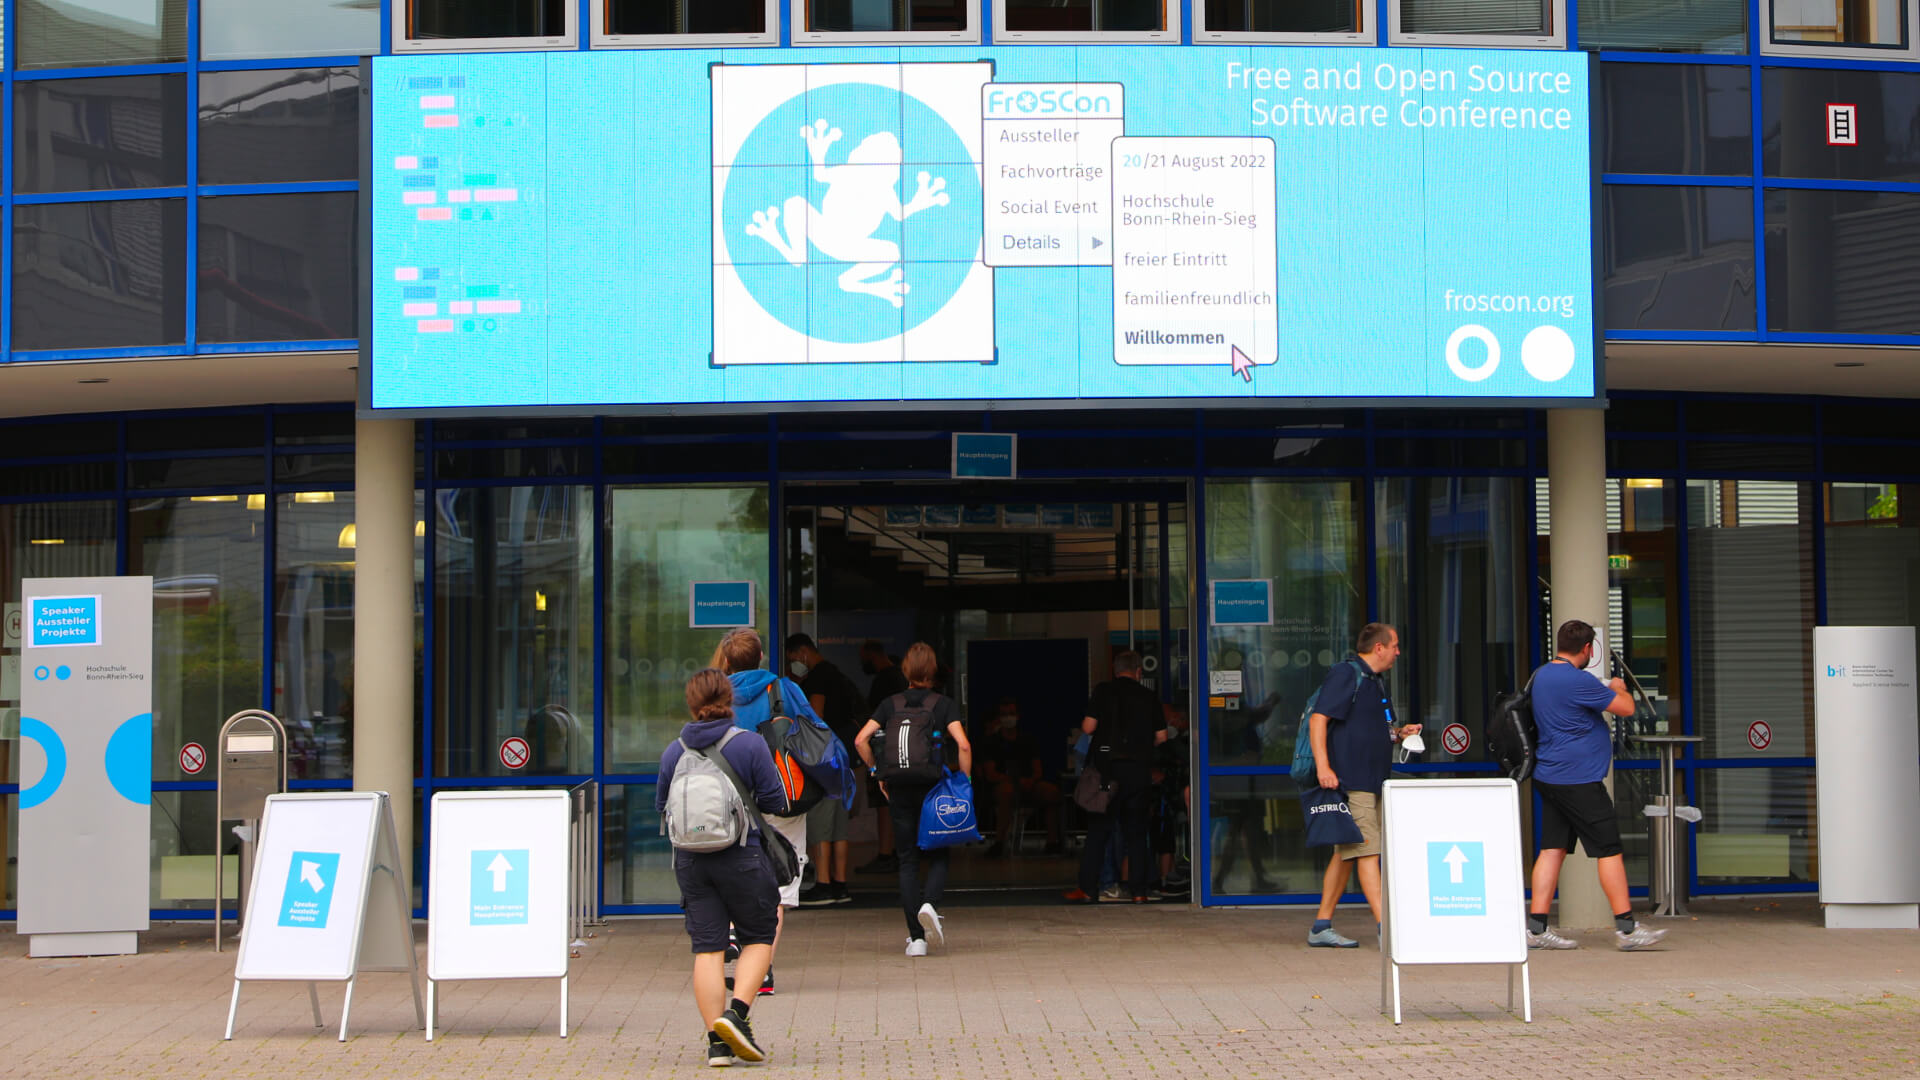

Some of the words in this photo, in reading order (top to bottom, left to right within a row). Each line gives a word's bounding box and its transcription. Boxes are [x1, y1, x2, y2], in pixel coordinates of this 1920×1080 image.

[1225, 61, 1291, 90] Free
[1303, 61, 1362, 90] and
[1374, 63, 1456, 97] Open
[1468, 65, 1572, 93] Source
[1251, 97, 1388, 127] Software
[1400, 98, 1572, 130] Conference
[1000, 129, 1080, 143] Aussteller
[1123, 154, 1166, 169] 20/21
[1172, 154, 1224, 171] August
[1230, 154, 1266, 168] 2022
[1001, 163, 1103, 180] Fachvorträge
[1000, 200, 1048, 214] Social
[1054, 200, 1098, 214] Event
[1123, 194, 1214, 208] Hochschule
[1123, 211, 1257, 229] Bonn-Rhein-Sieg
[1003, 235, 1061, 250] Details
[1124, 251, 1167, 266] freier
[1173, 252, 1228, 266] Eintritt
[1124, 291, 1271, 305] familienfreundlich
[1444, 289, 1575, 318] froscon.org
[1124, 330, 1225, 345] Willkommen
[697, 600, 746, 608] Haupteingang
[41, 607, 86, 617] Speaker
[36, 617, 91, 626] Aussteller
[41, 628, 87, 638] Projekte
[86, 665, 127, 673] Hochschule
[1827, 664, 1846, 677] b-it
[86, 673, 144, 681] Bonn-Rhein-Sieg
